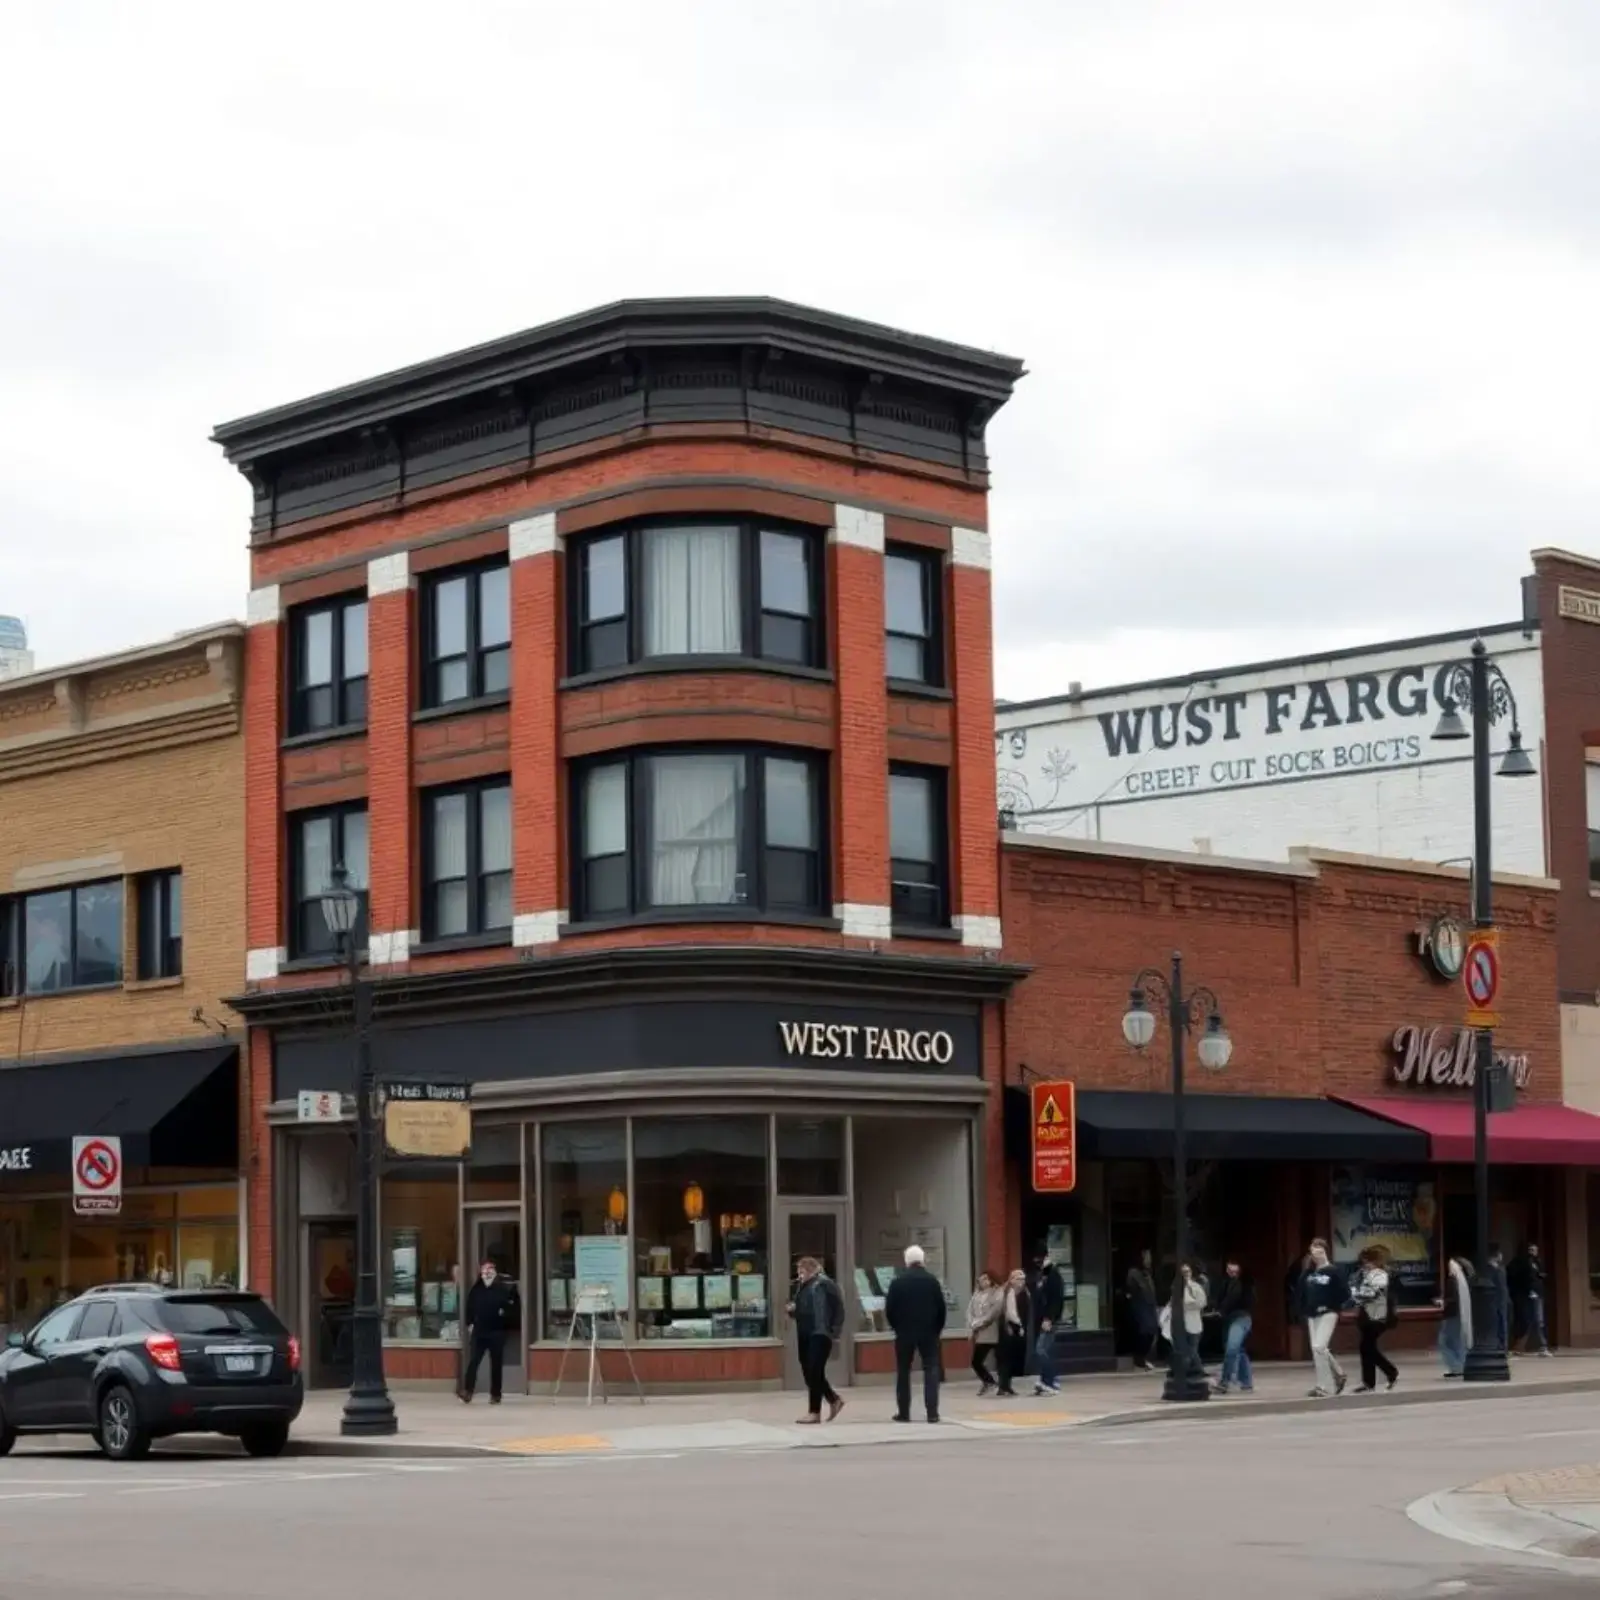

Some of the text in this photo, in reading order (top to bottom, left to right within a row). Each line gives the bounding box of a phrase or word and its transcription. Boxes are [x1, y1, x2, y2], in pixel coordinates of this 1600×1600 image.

[1098, 694, 1247, 757] WUST
[779, 1021, 954, 1064] WEST FARGO
